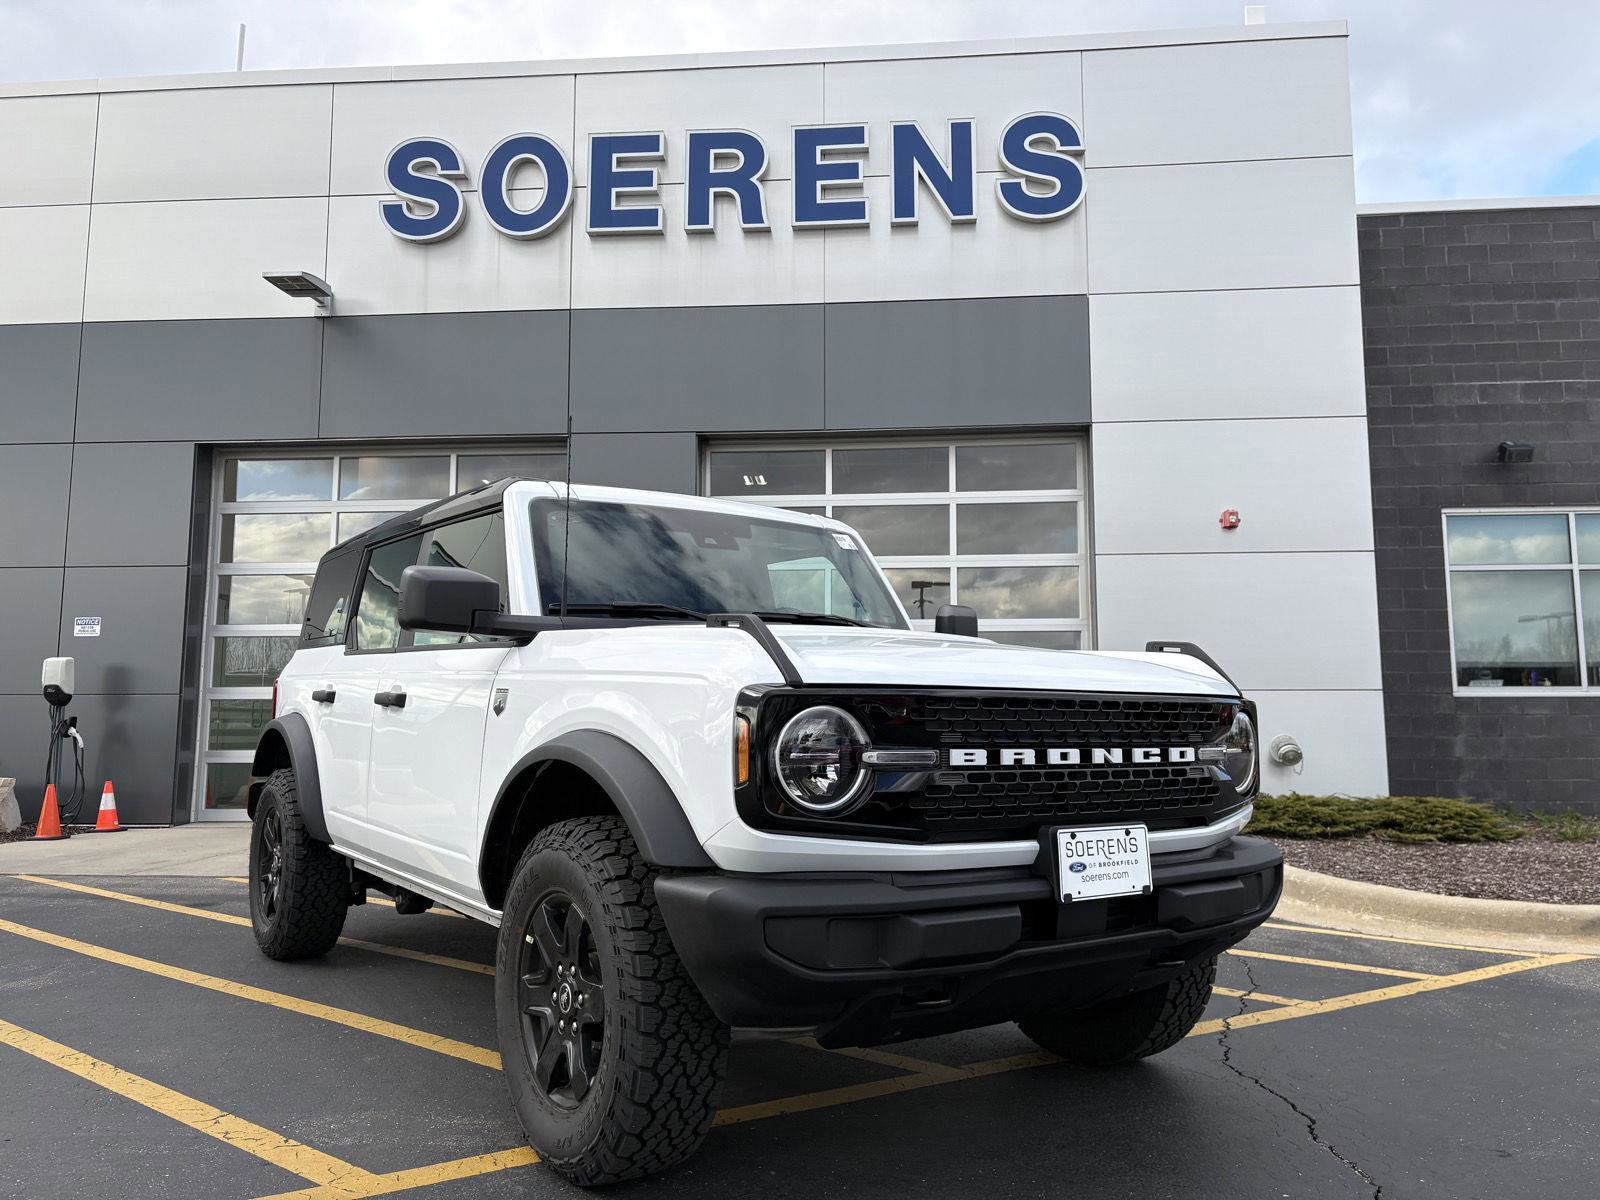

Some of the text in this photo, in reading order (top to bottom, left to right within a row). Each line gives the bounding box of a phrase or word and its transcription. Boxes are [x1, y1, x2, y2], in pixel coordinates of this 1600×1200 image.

[380, 111, 1088, 242] SOERENS
[950, 747, 1196, 766] BRONCO
[1065, 837, 1139, 860] SOERENS
[1098, 859, 1138, 867] BROOKFIELD
[1081, 871, 1129, 882] soerens.com
